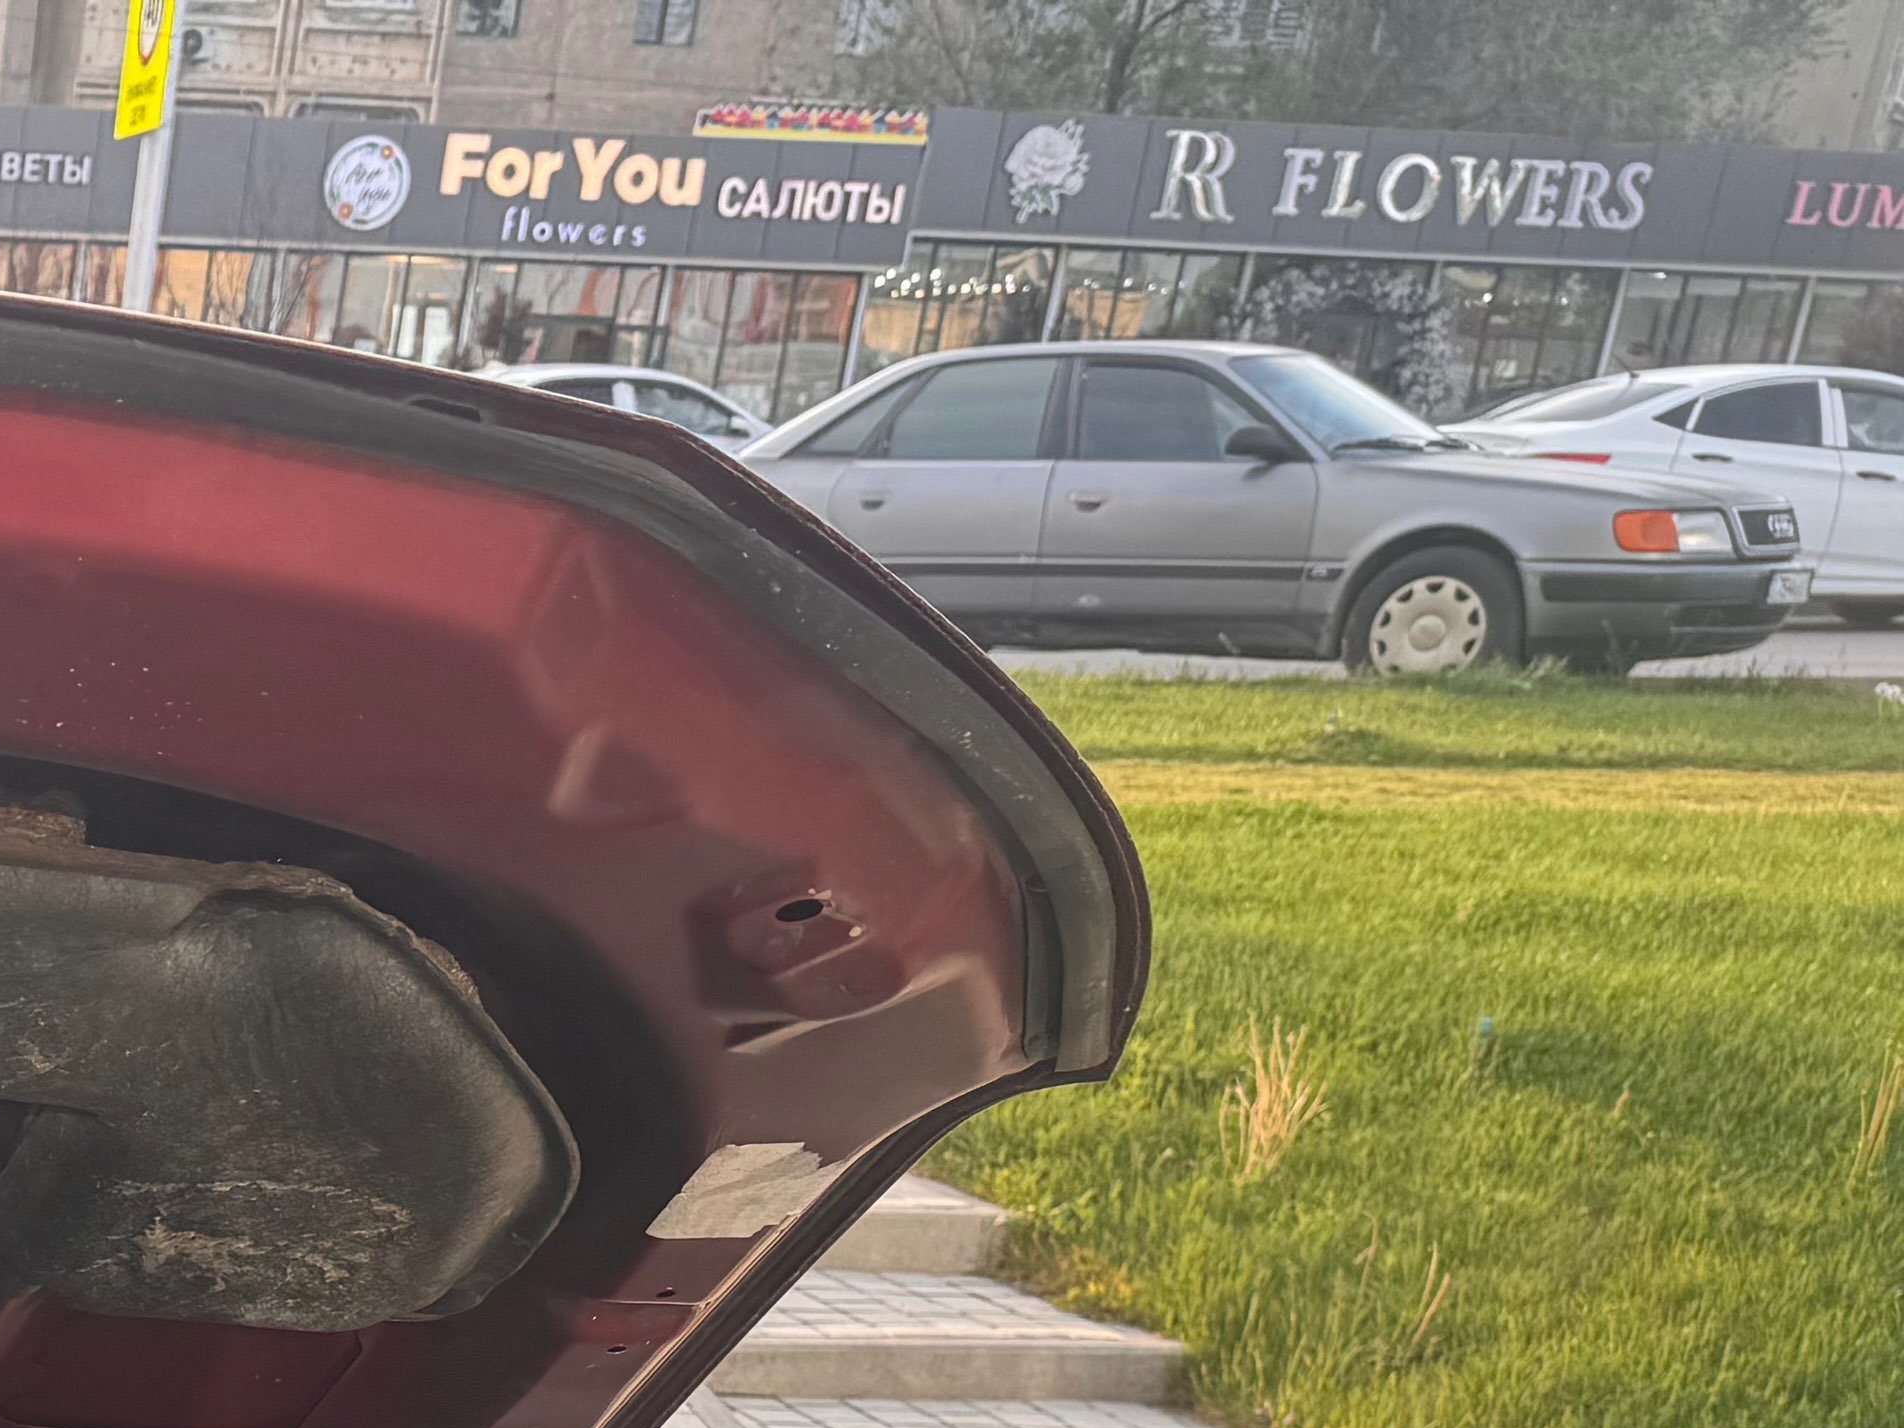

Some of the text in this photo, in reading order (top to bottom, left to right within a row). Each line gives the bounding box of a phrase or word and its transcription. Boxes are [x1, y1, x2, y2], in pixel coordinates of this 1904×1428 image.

[439, 133, 707, 207] For You
[716, 175, 907, 225] САЛЮТЫ
[1271, 147, 1655, 231] FLOWERS
[500, 206, 648, 248] flowers
